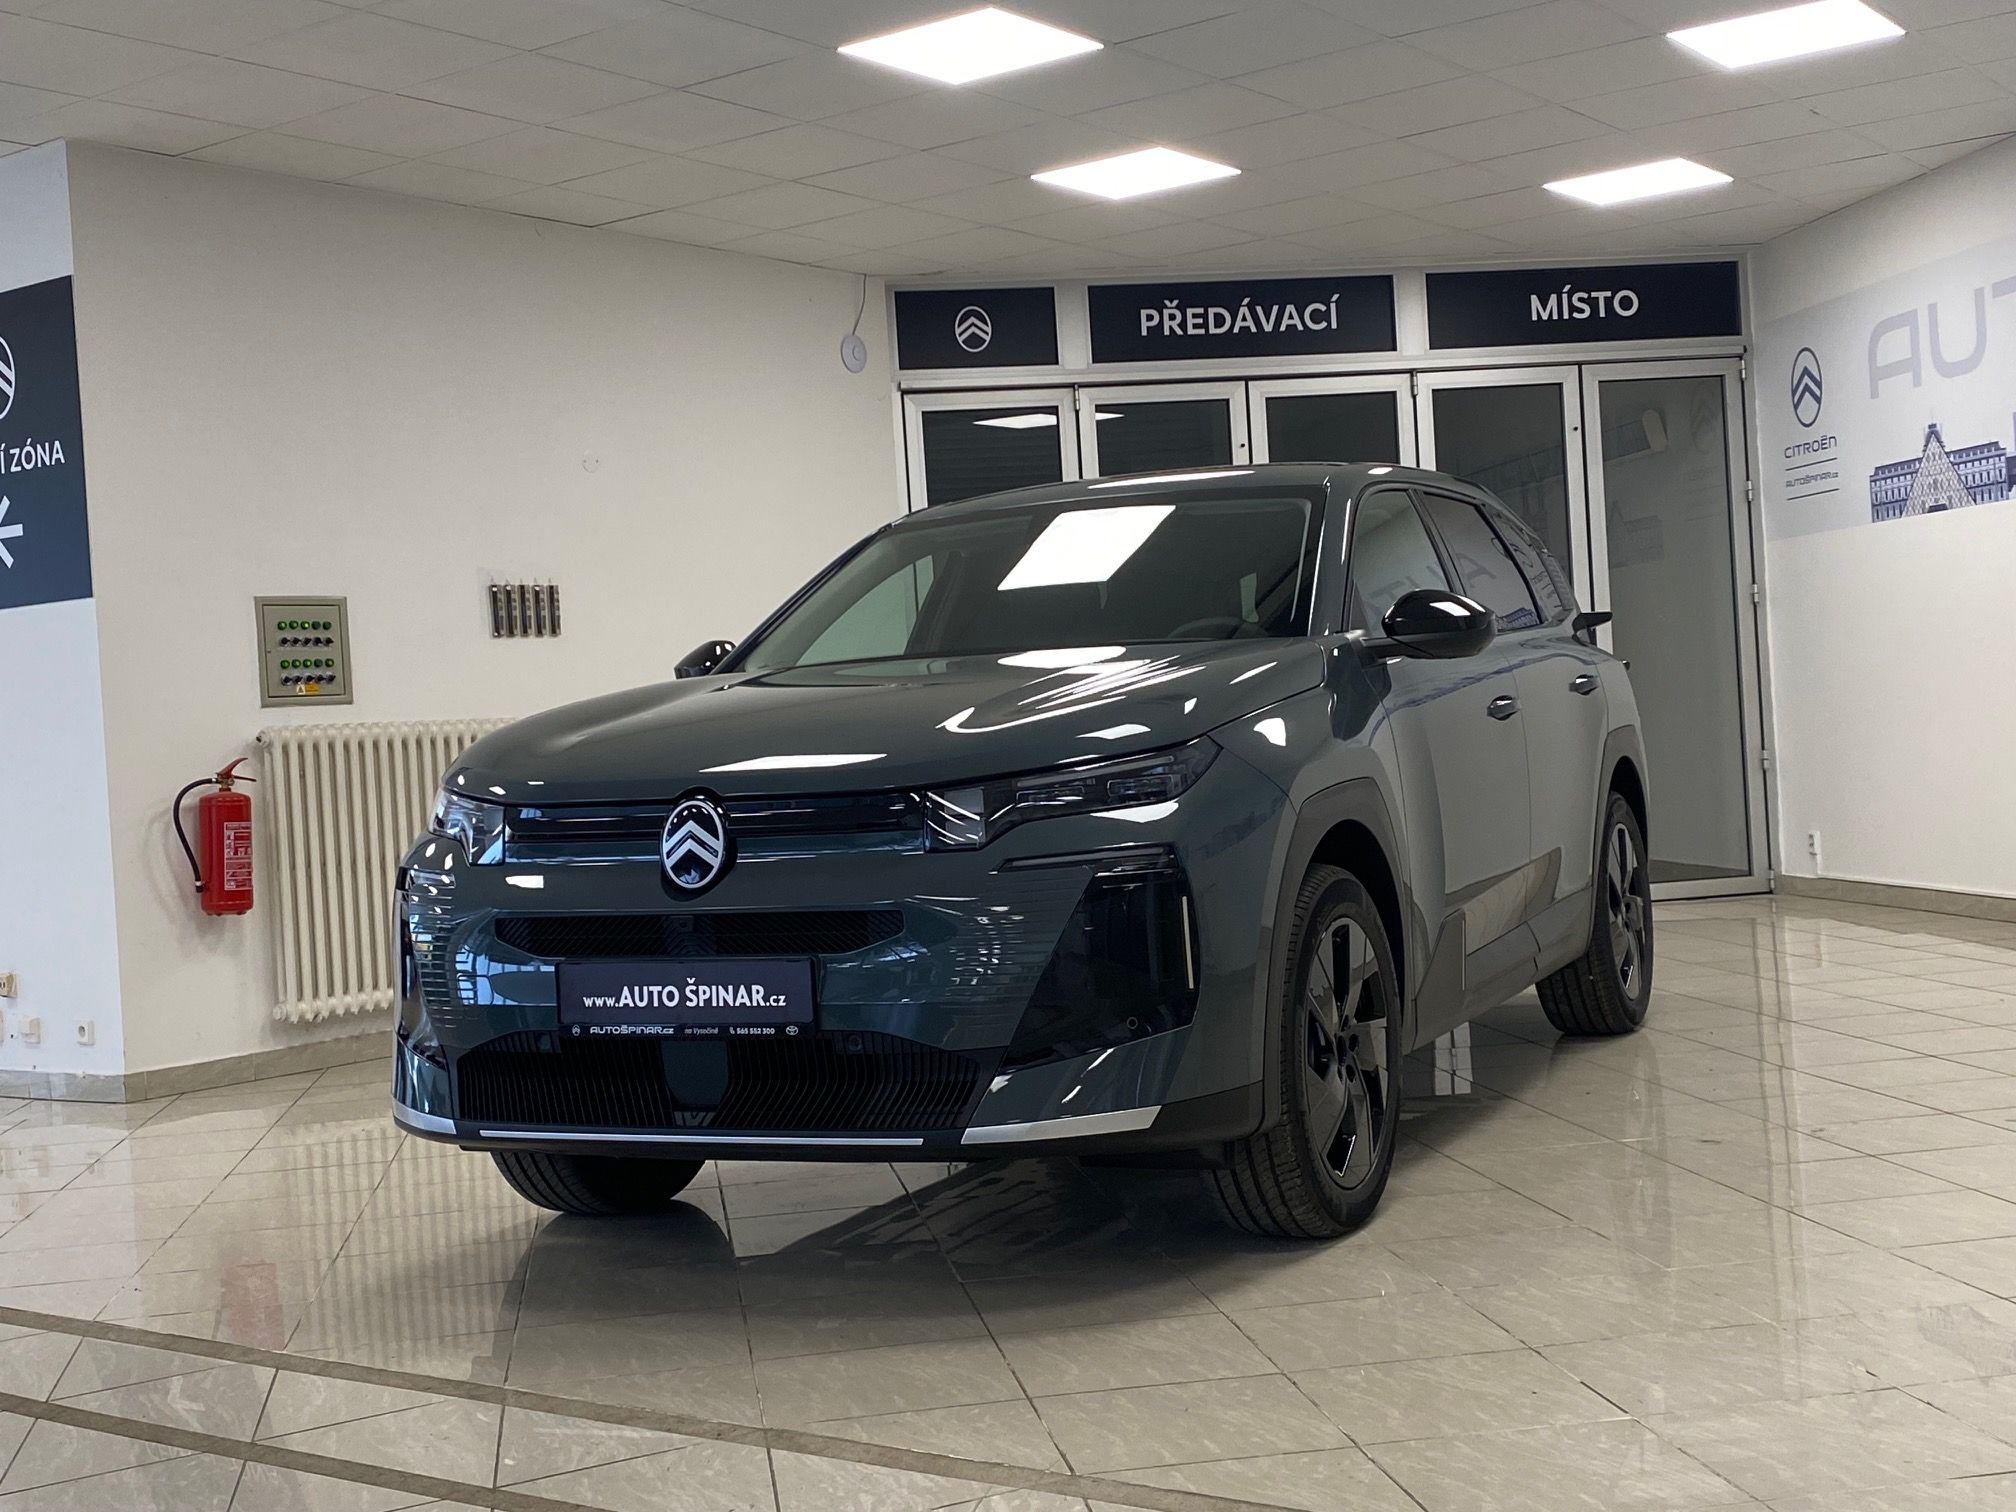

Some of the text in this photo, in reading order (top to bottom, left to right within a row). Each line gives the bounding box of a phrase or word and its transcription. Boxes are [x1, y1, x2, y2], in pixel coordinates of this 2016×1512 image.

[1140, 284, 1640, 337] PŘEDÁVACÍ MÍSTO
[10, 438, 66, 473] ZÓNA
[582, 977, 787, 1008] www.AUTO ŠPINAR.cz
[736, 1027, 749, 1035] 565
[762, 1027, 776, 1035] 300
